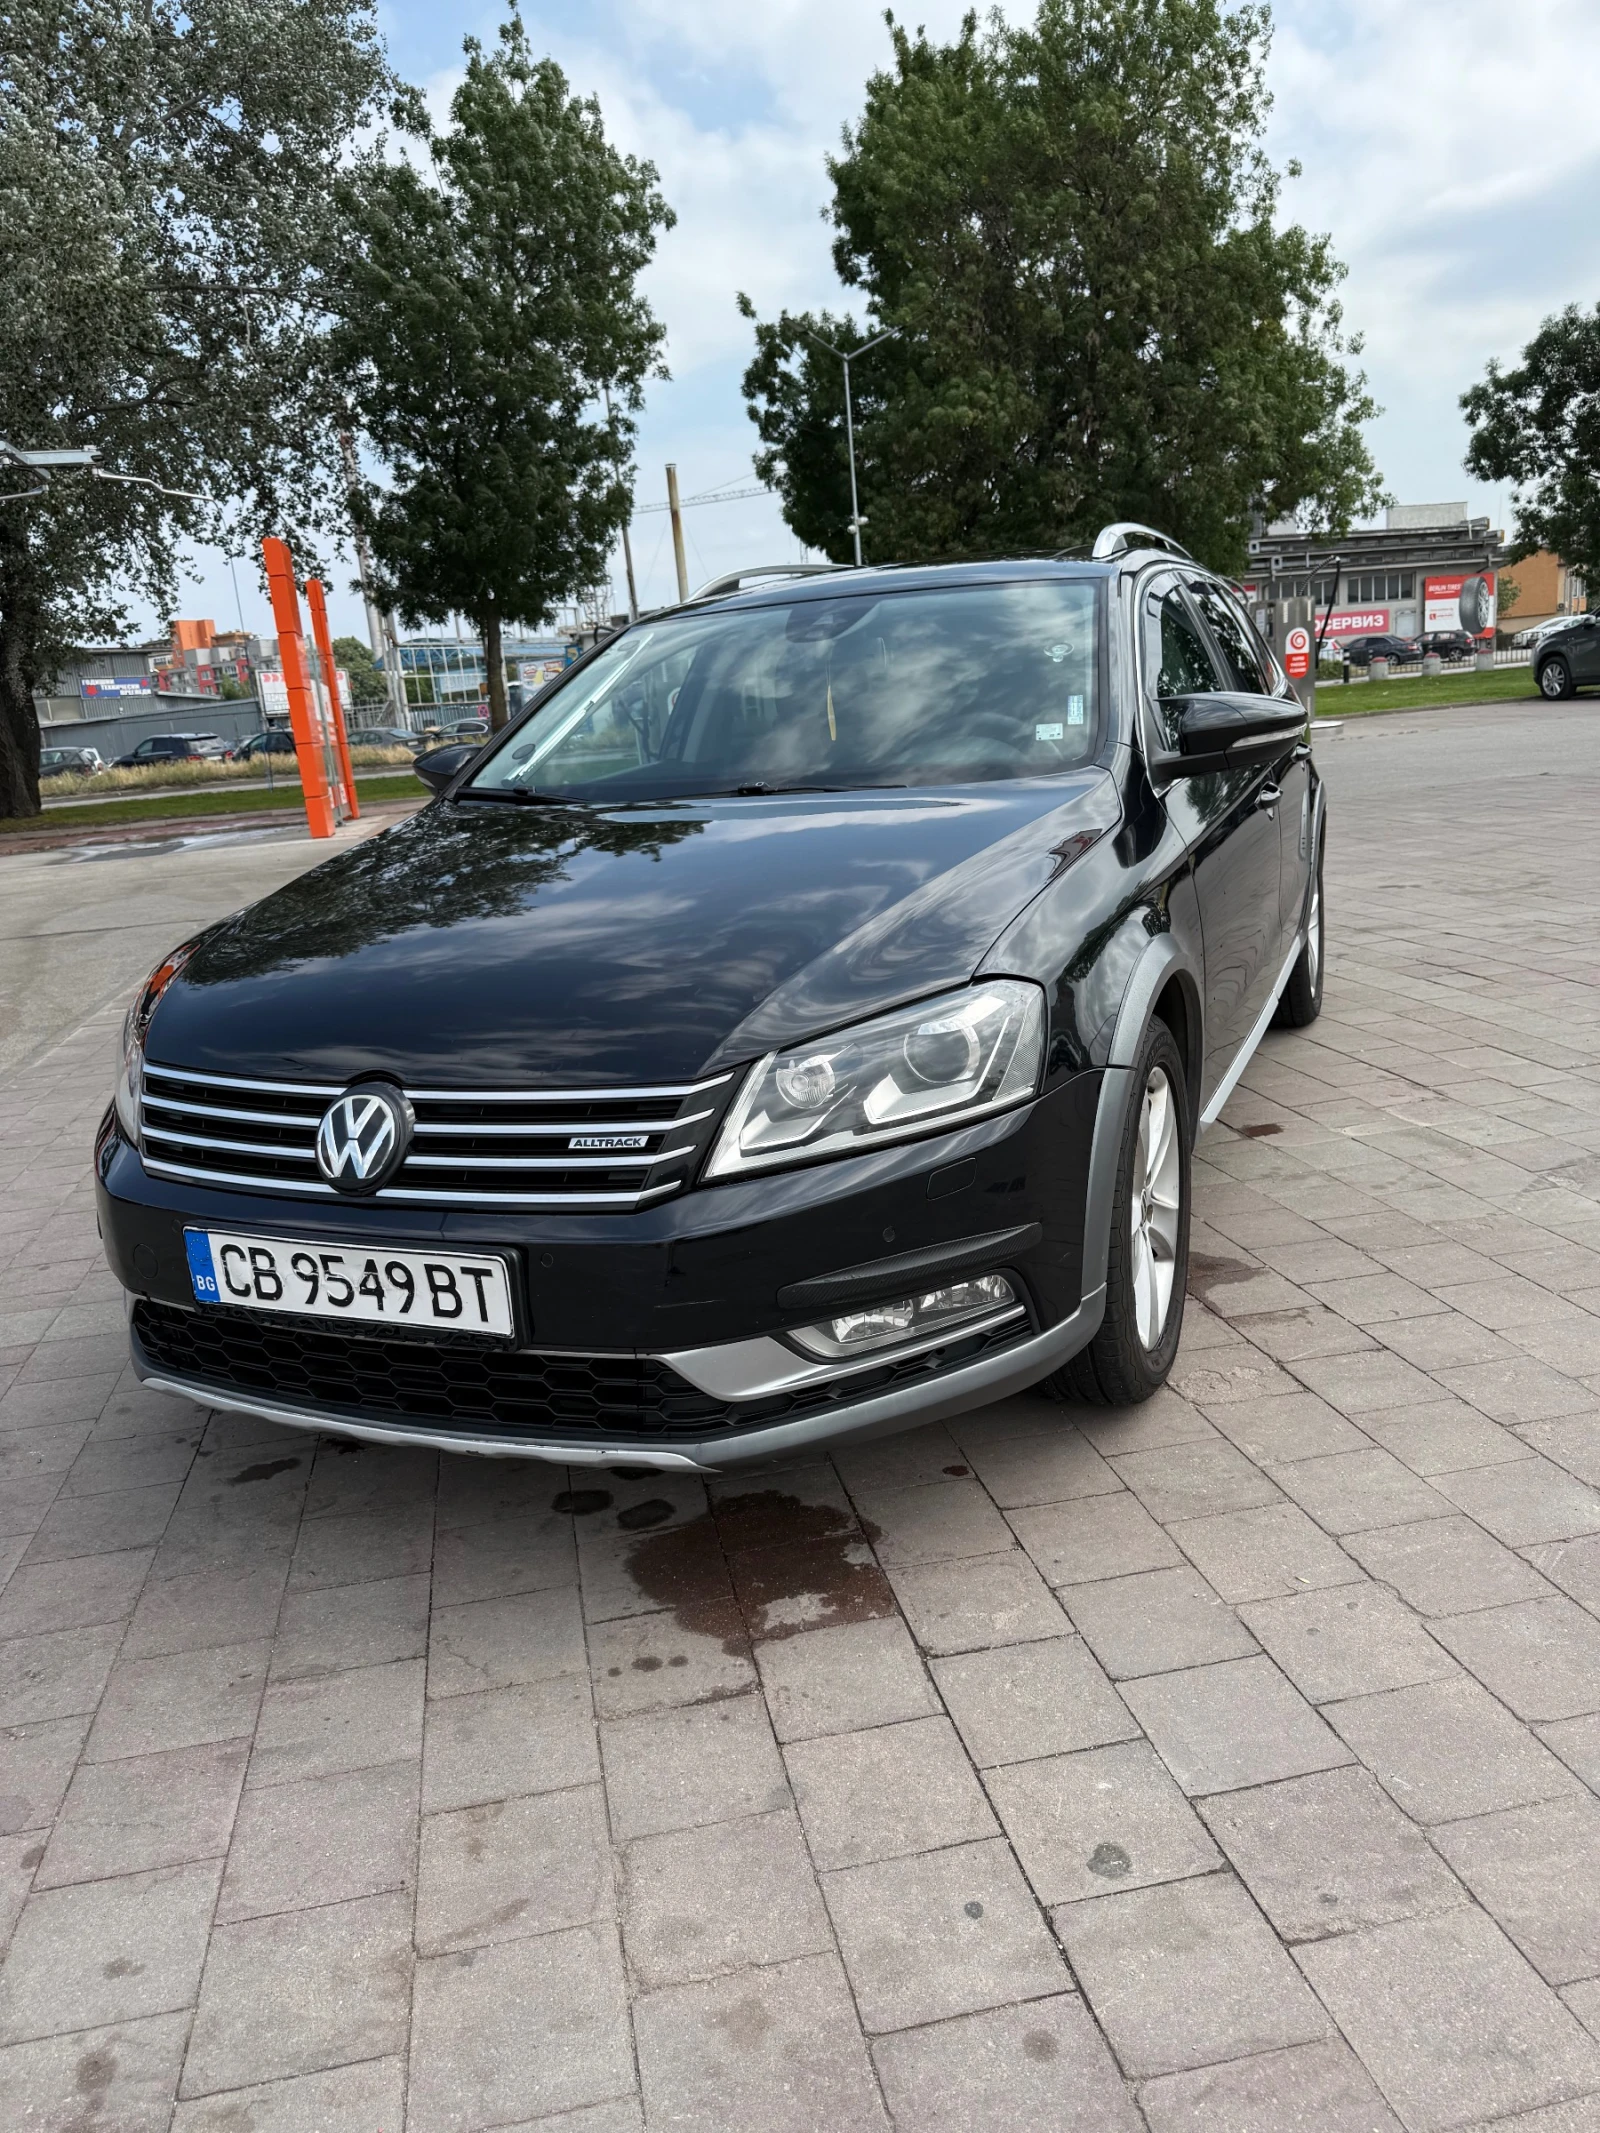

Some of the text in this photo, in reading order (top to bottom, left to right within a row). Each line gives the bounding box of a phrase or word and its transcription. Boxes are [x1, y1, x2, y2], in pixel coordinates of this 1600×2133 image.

[573, 1138, 642, 1148] ALLTRACK
[196, 1274, 216, 1292] BG
[220, 1243, 493, 1323] CB 9549 BT
